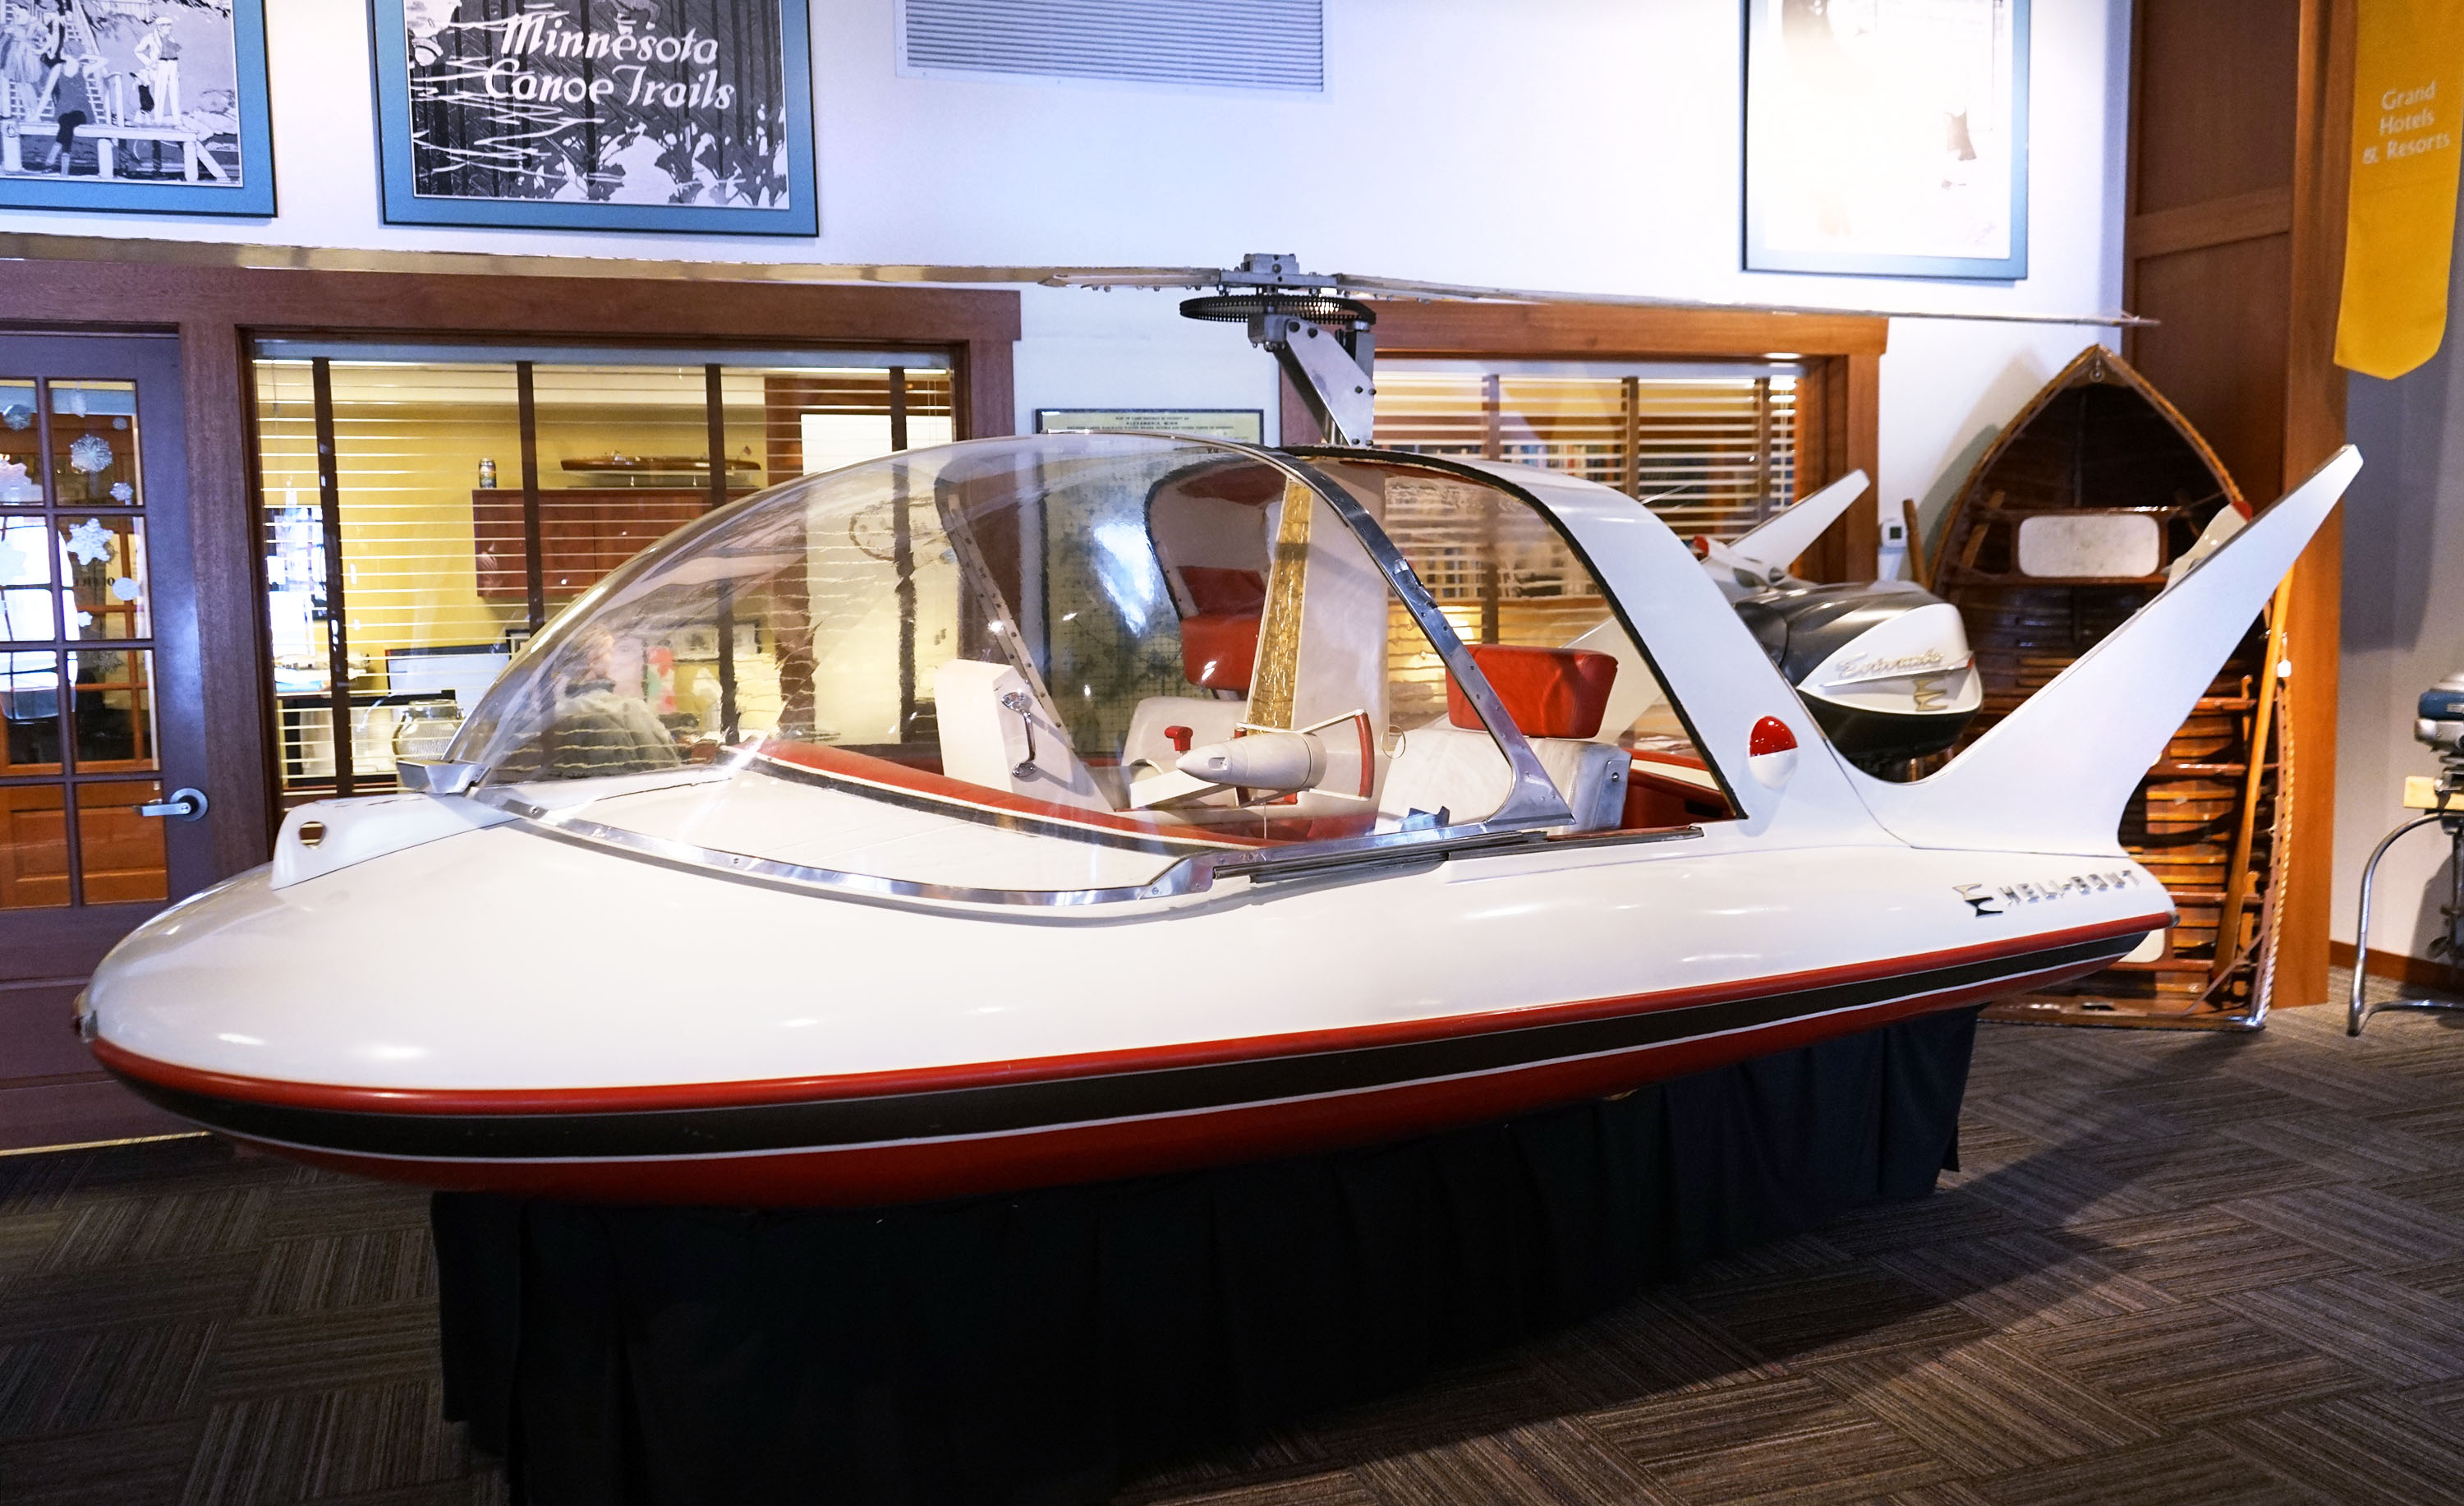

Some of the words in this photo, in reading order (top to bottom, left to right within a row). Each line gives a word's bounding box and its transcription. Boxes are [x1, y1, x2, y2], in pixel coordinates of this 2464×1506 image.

[501, 13, 718, 64] Minnesota
[484, 58, 614, 104] Canoe
[612, 66, 736, 109] Trails
[2382, 80, 2437, 110] Grand
[2379, 108, 2435, 136] Hotels
[2362, 145, 2379, 164] &
[2387, 133, 2451, 160] Resorts
